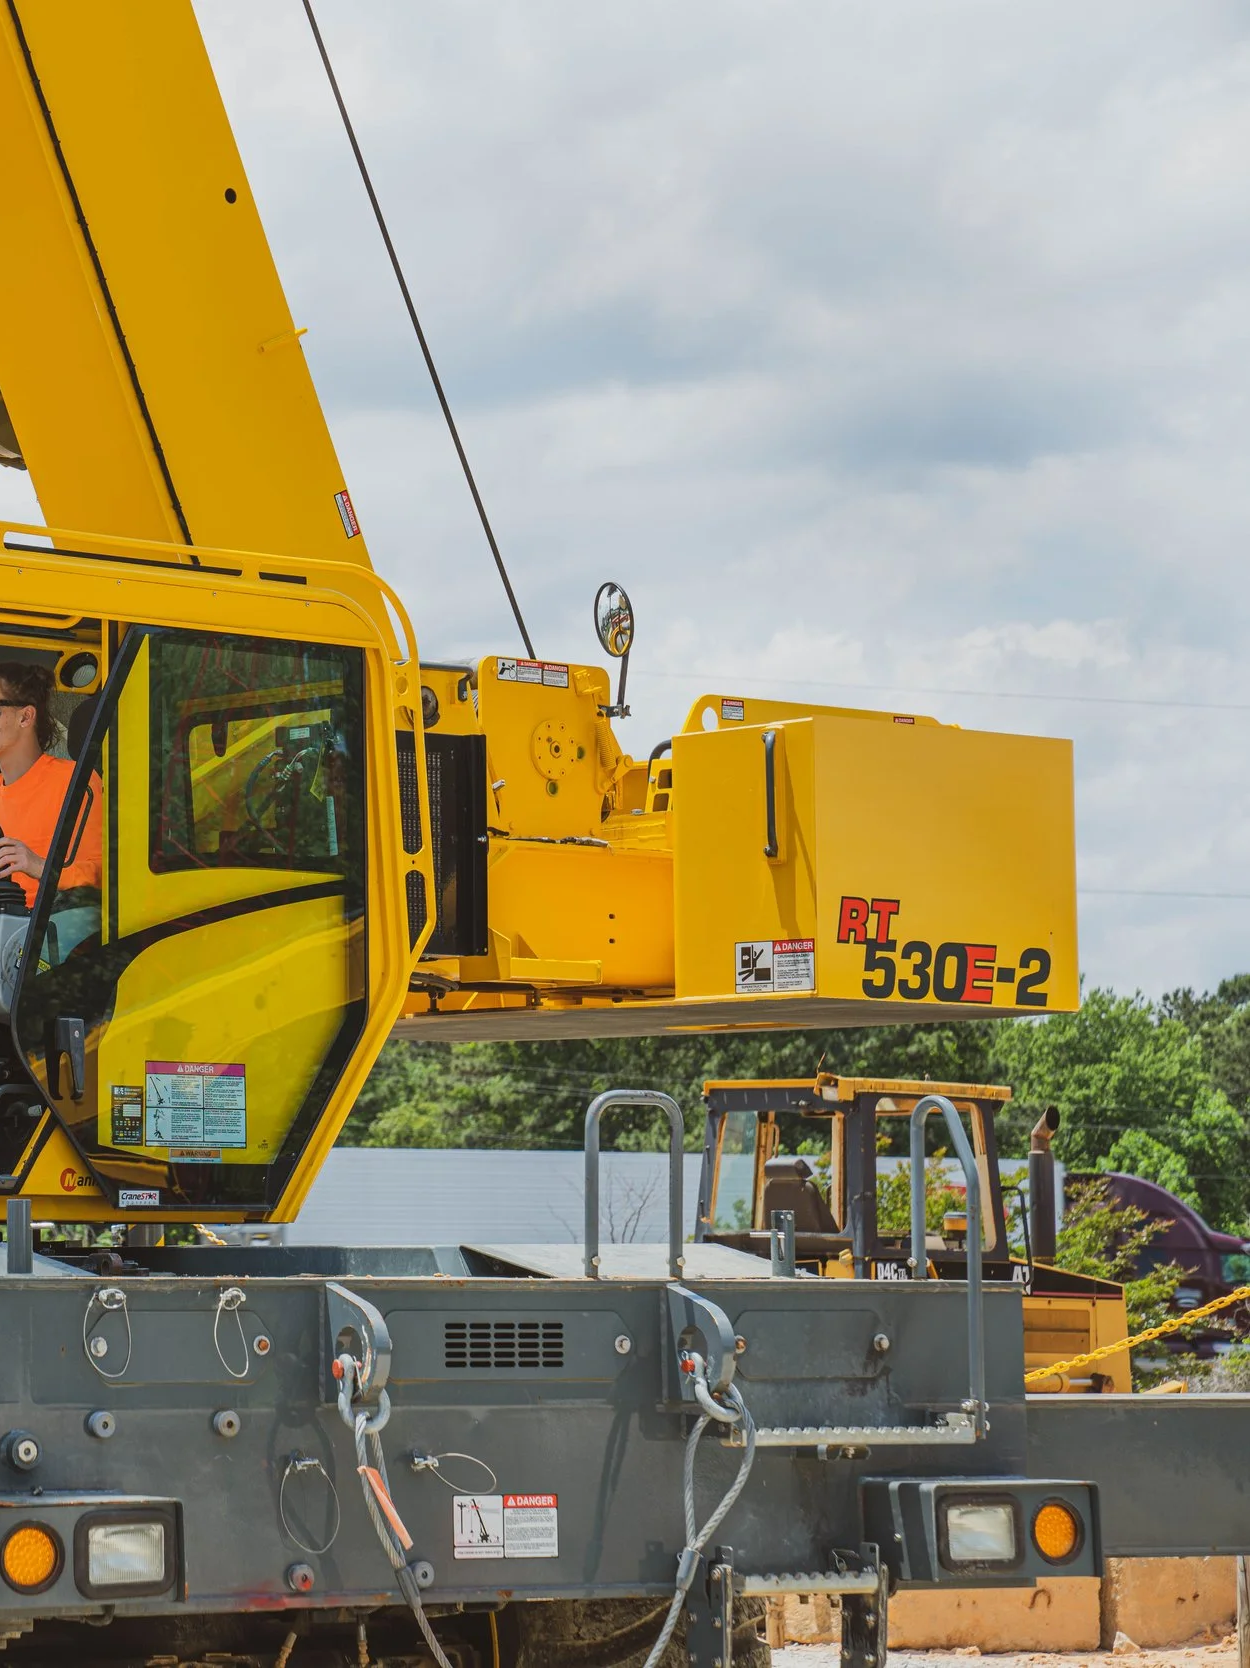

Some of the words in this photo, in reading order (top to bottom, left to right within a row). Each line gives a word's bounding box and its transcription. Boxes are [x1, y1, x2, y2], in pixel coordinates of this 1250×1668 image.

[344, 501, 358, 531] DANGER
[549, 664, 568, 673] DANGER
[837, 896, 900, 945] RT
[782, 942, 813, 951] DANGER
[862, 938, 1051, 1007] 530E-2
[185, 1065, 214, 1074] DANGER
[877, 1262, 898, 1280] D4C
[516, 1496, 554, 1506] DANGER
